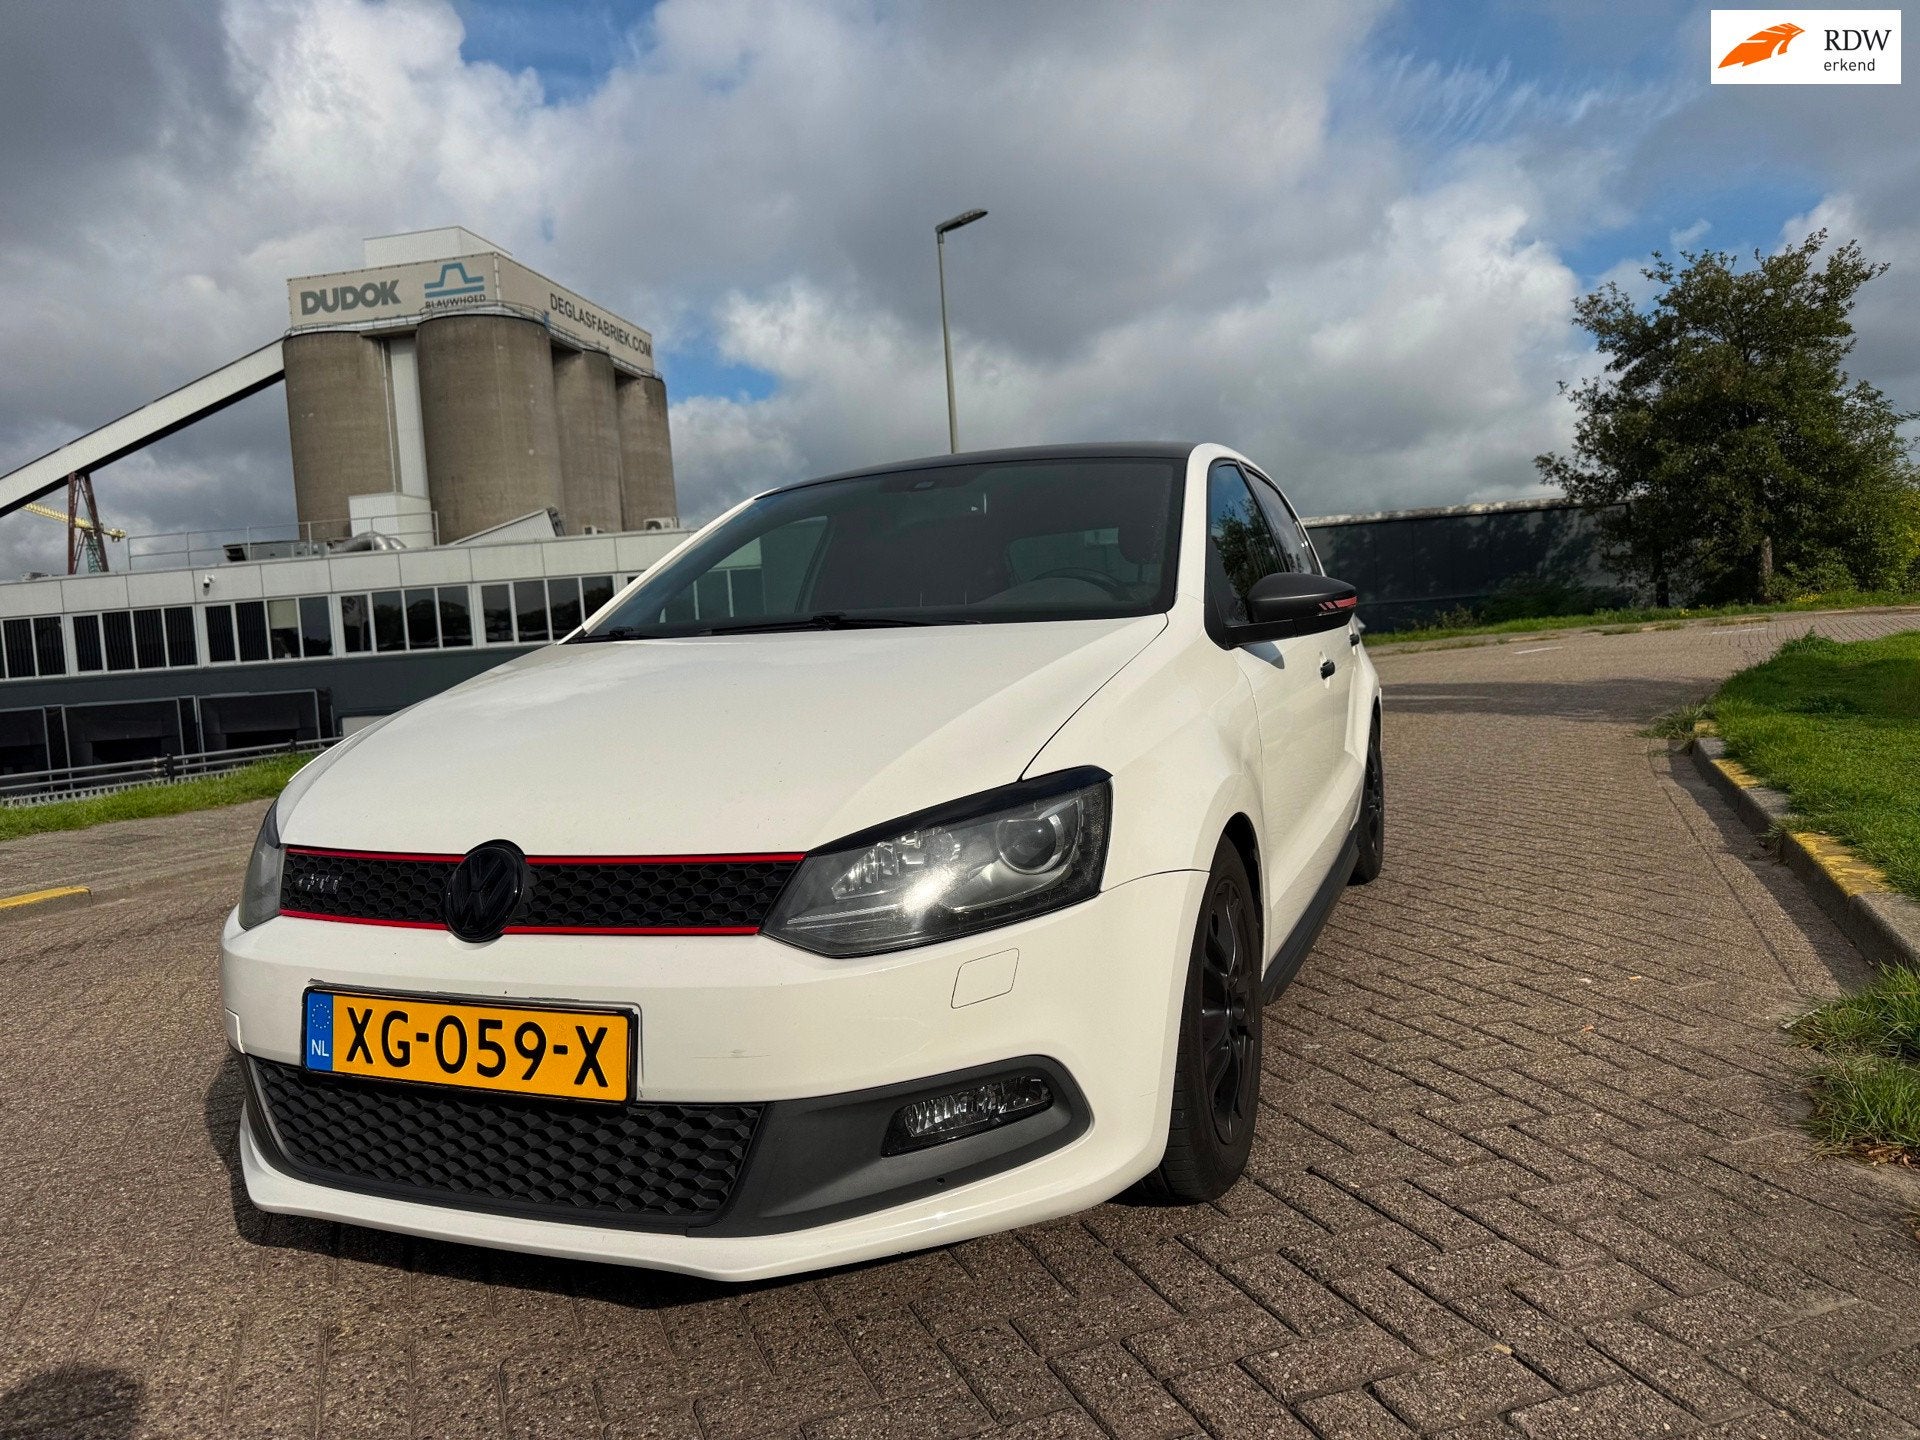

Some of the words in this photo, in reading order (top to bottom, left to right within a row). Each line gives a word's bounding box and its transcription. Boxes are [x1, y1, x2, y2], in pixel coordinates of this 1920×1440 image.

[301, 279, 400, 316] DUDOK
[550, 293, 652, 357] DEGLASFABRIEK.COM
[311, 1038, 330, 1057] NL
[346, 1006, 609, 1088] XG-059-X
